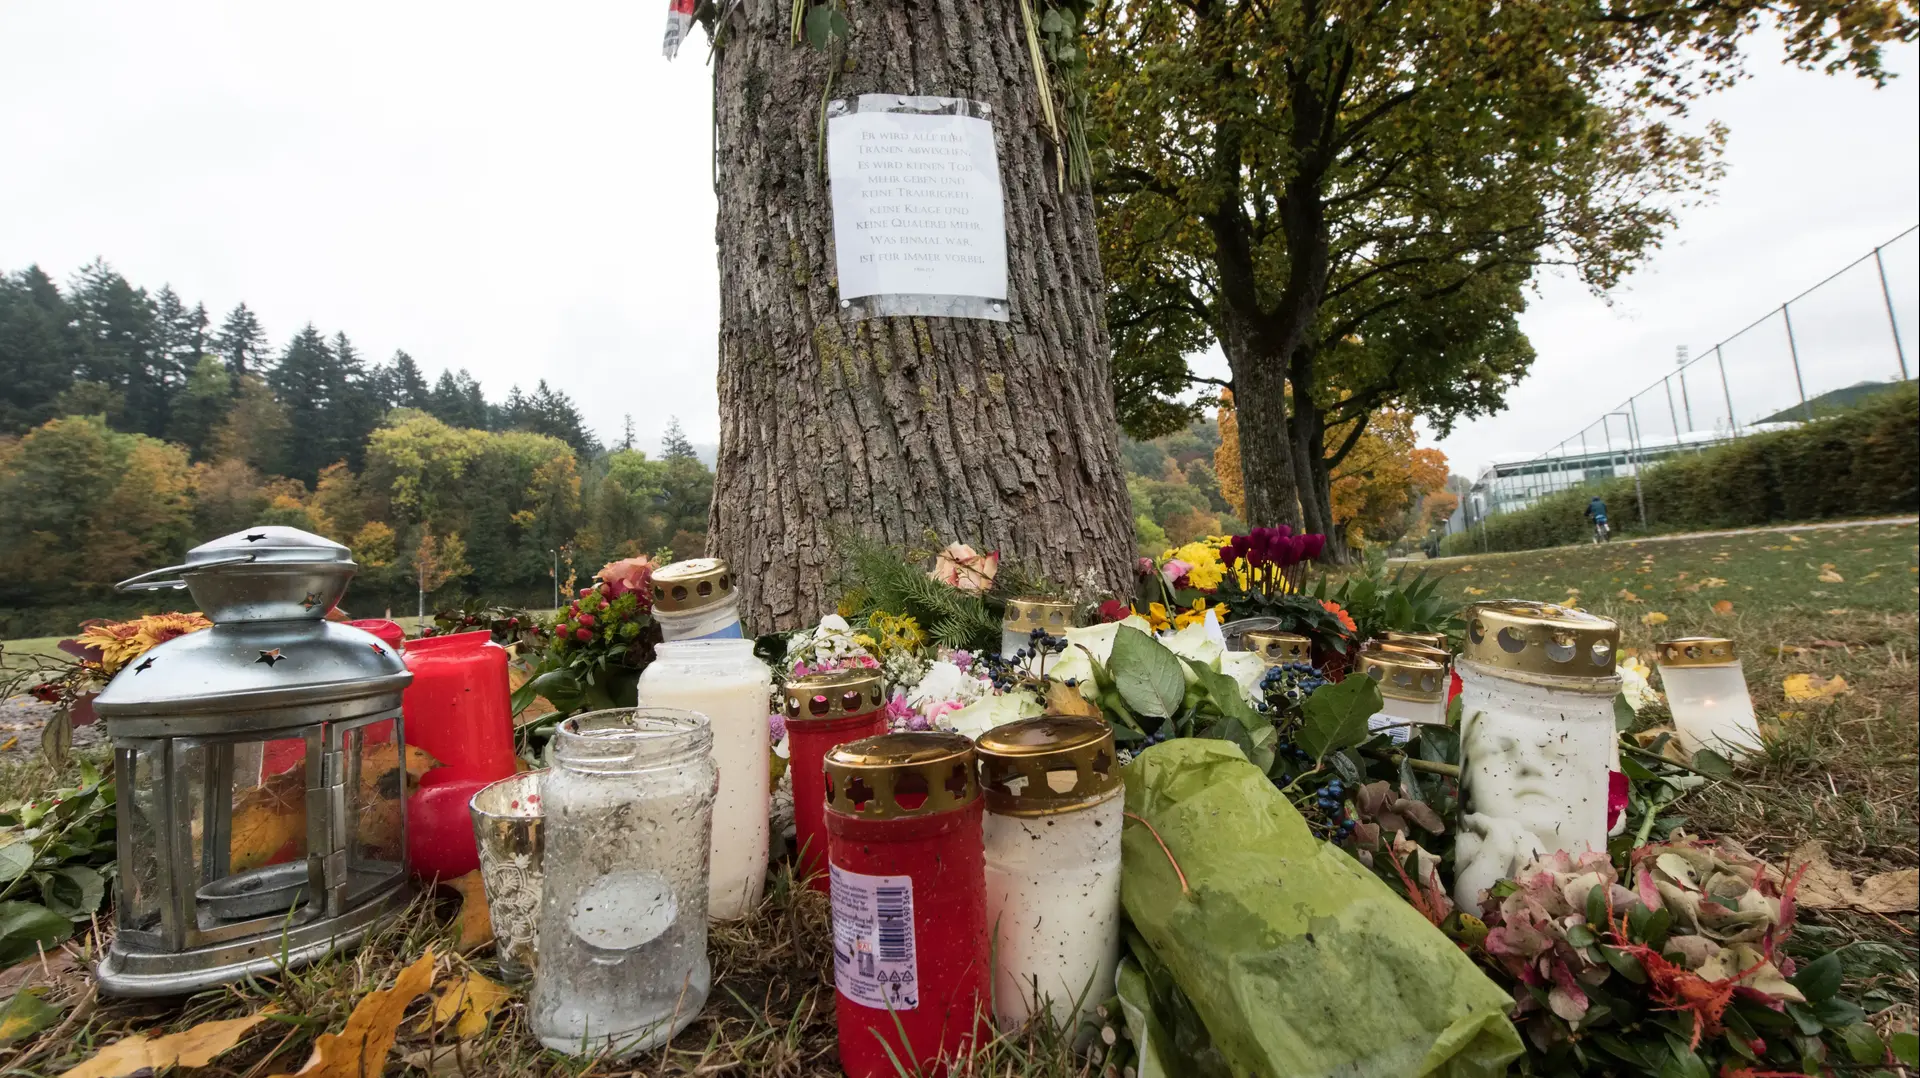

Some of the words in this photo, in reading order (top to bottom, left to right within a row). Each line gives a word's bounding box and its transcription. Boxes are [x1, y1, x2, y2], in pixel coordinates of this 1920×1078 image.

[862, 131, 876, 140] ER
[880, 132, 909, 140] WIRD
[912, 132, 938, 141] ALLE
[858, 161, 870, 170] ES
[873, 161, 903, 170] WIRD
[906, 161, 946, 171] KEINEN
[868, 175, 901, 184] MEHR
[903, 175, 937, 184] GEBEN
[940, 176, 966, 185] UND
[861, 189, 893, 199] KEINE
[869, 205, 901, 215] KEINE
[904, 203, 942, 214] KLAGE
[944, 206, 970, 215] UND
[856, 219, 888, 230] KEINE
[870, 236, 897, 245] WAS
[900, 236, 942, 245] EINMAL
[859, 254, 875, 264] IST
[904, 253, 941, 262] IMMER
[903, 889, 911, 922] 690364
[904, 926, 913, 959] 010355
